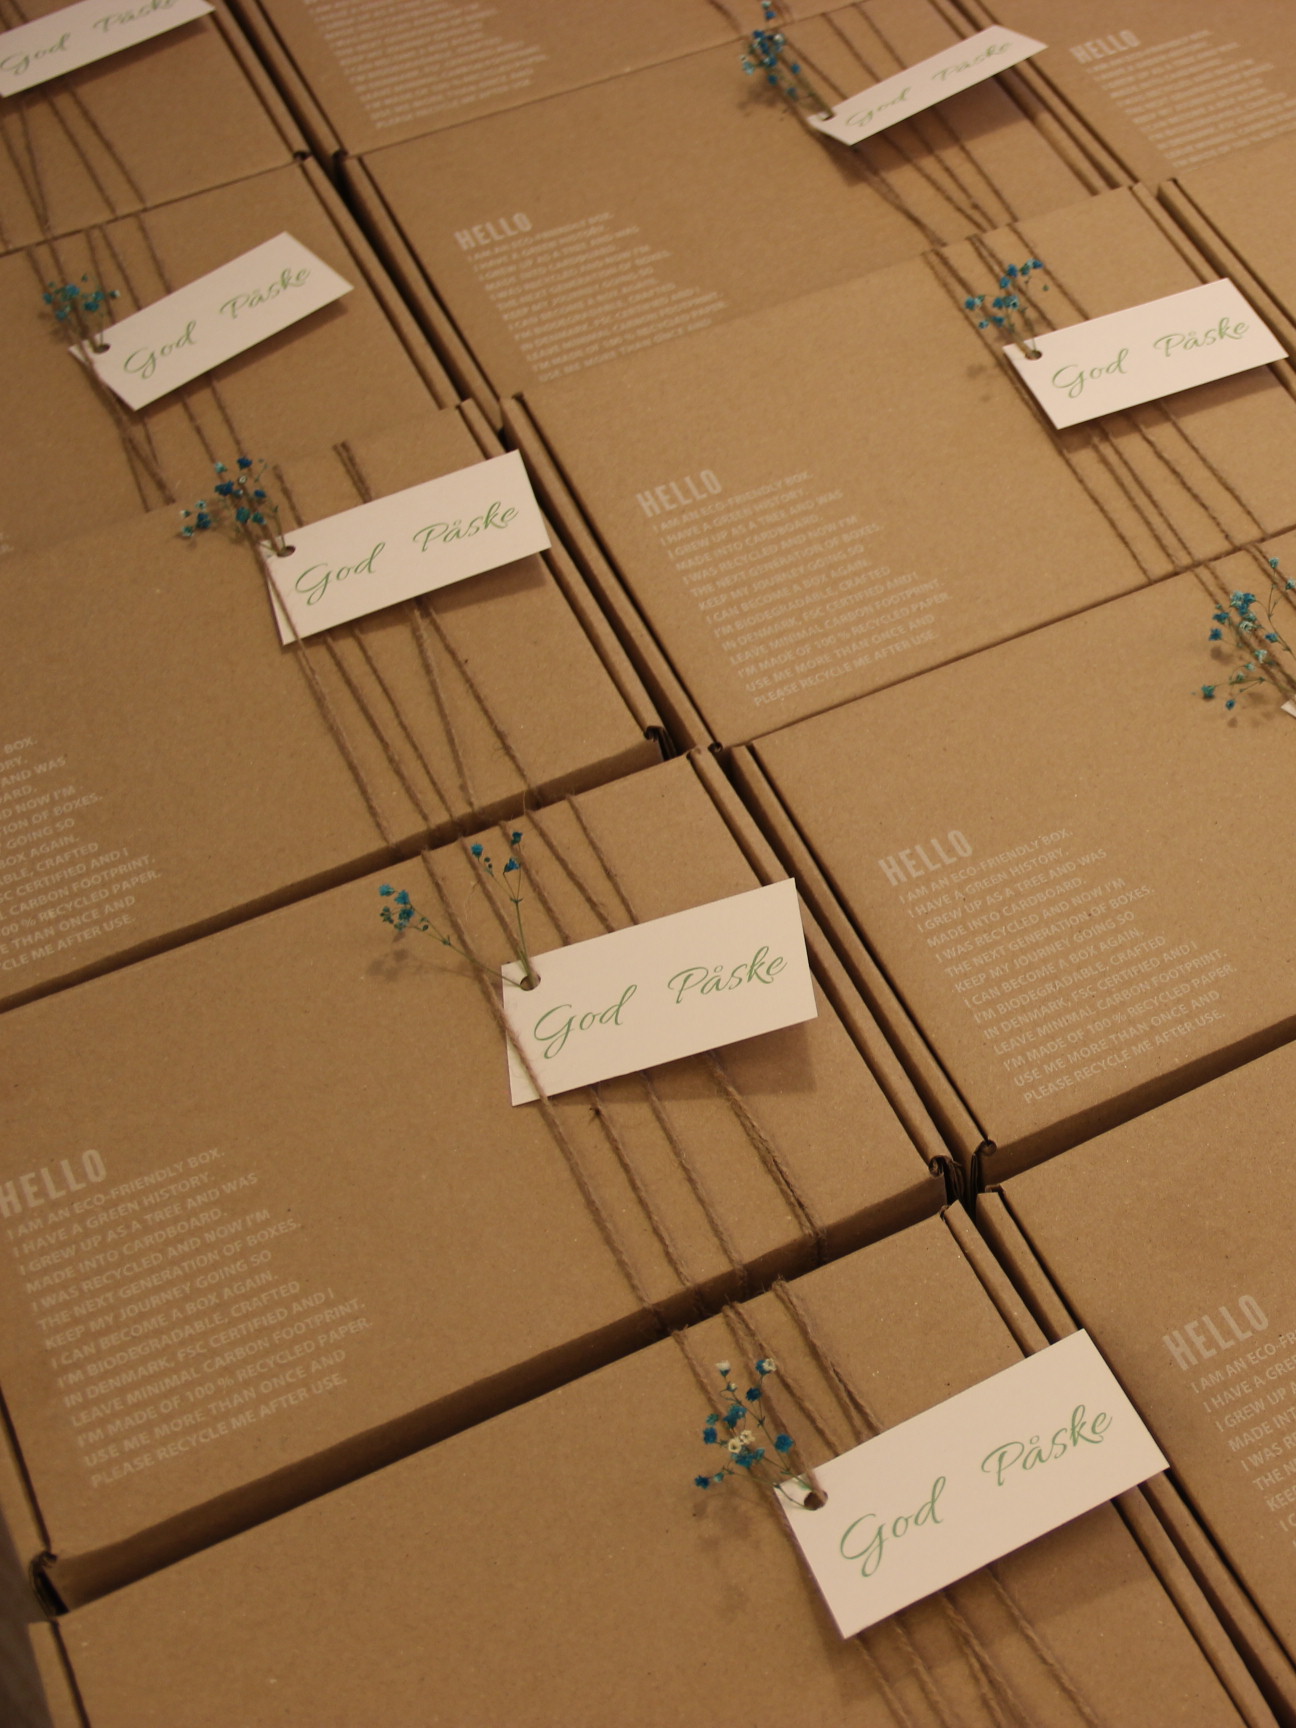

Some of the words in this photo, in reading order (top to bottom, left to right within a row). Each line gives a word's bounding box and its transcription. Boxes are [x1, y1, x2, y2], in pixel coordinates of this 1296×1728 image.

[1069, 29, 1141, 65] HELLO
[845, 88, 912, 127] God
[454, 212, 533, 251] HELLO
[121, 320, 199, 381] God
[217, 262, 311, 321] Påske
[1051, 348, 1131, 399] God
[1153, 315, 1251, 359] Påske
[635, 469, 722, 518] HELLO
[293, 542, 387, 608] God
[411, 499, 520, 556] Påske
[35, 842, 98, 871] CRAFTED
[877, 829, 972, 886] HELLO
[7, 886, 69, 916] CARBON
[944, 960, 972, 977] THE
[972, 944, 1006, 966] NEXT
[1008, 911, 1089, 950] GENERATION
[1090, 902, 1106, 916] OF
[1109, 935, 1166, 965] CRAFTED
[532, 983, 639, 1062] God
[665, 943, 787, 1012] Påske
[0, 1148, 106, 1218] HELLO
[26, 1266, 75, 1293] MADE
[78, 1249, 118, 1273] INTO
[1161, 1294, 1268, 1371] HELLO
[71, 1397, 123, 1428] LEAVE
[125, 1367, 198, 1405] MINIMAL
[202, 1337, 269, 1372] CARBON
[1200, 1370, 1224, 1390] AM
[1225, 1357, 1247, 1377] AN
[1210, 1380, 1252, 1408] HAVE
[1223, 1398, 1265, 1427] GREW
[1266, 1387, 1286, 1405] UP
[1227, 1421, 1273, 1452] MADE
[1247, 1442, 1283, 1466] WAS
[837, 1475, 949, 1580] God
[980, 1400, 1112, 1489] Påske
[1252, 1468, 1284, 1490] THE
